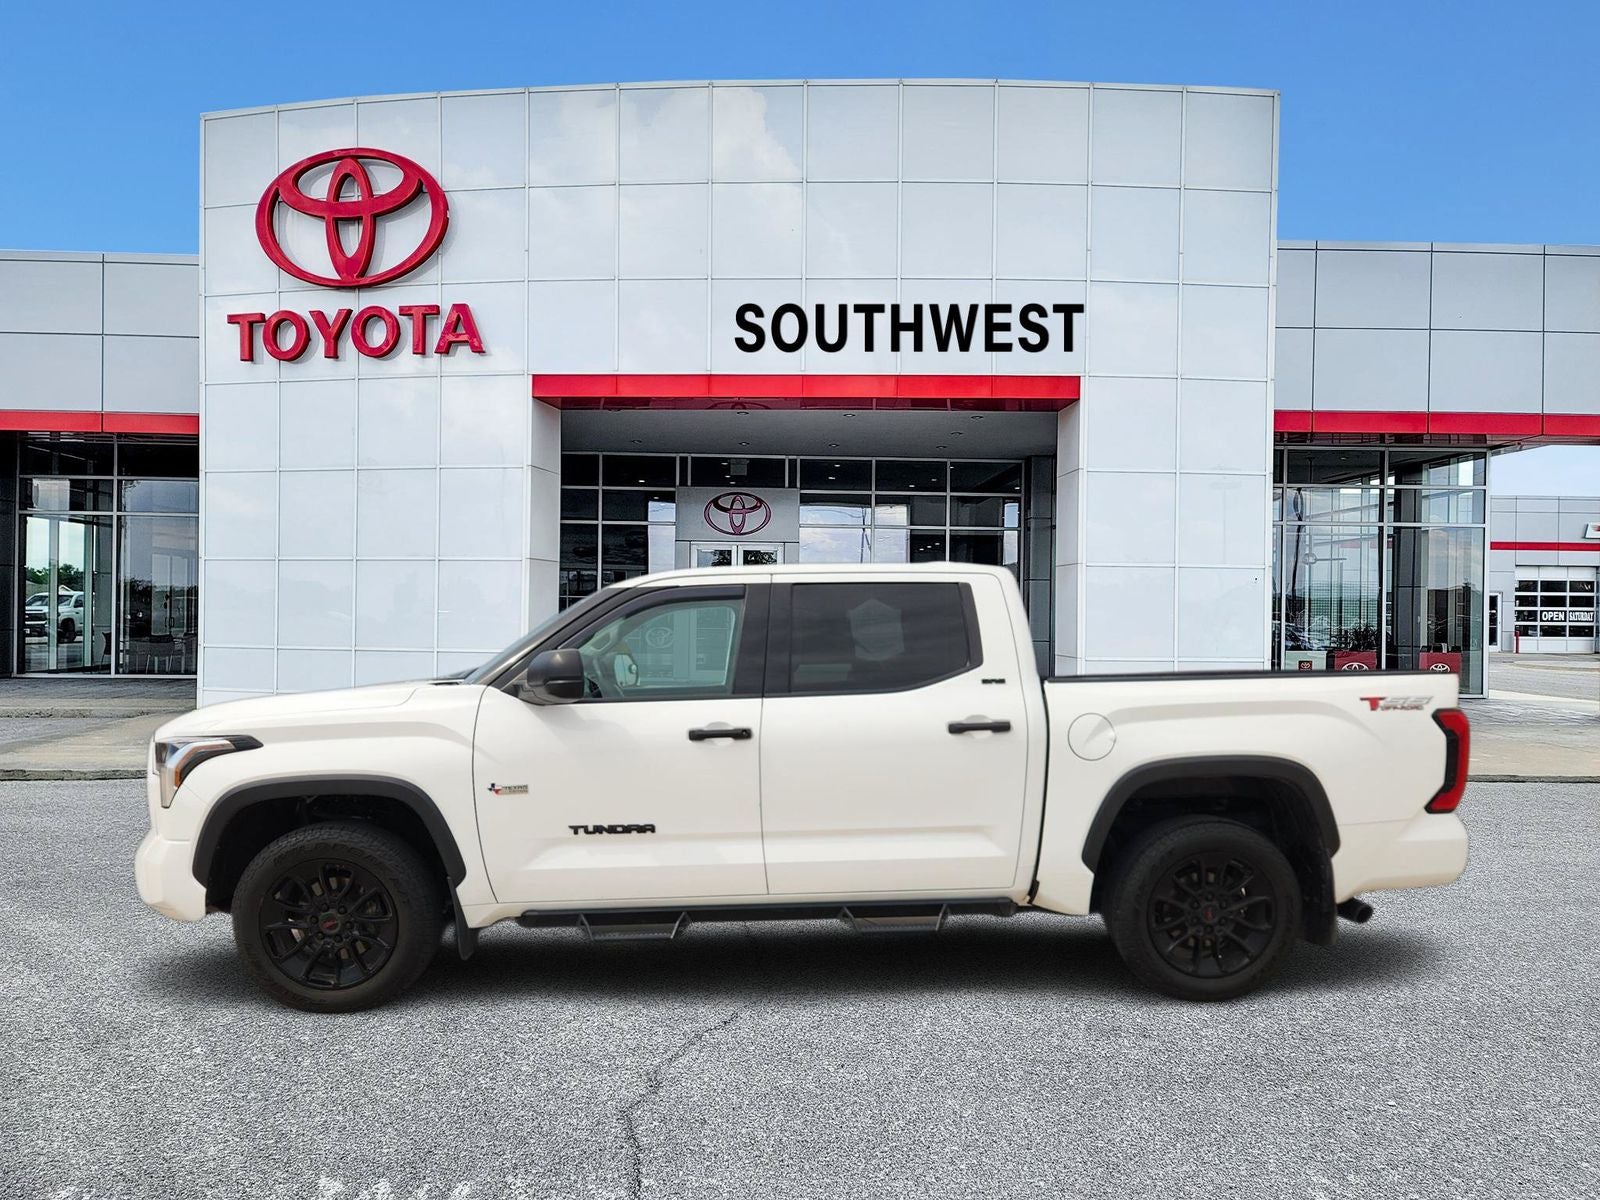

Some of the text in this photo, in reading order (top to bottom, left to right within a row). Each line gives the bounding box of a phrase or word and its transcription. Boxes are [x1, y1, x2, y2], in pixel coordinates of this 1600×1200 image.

[226, 303, 486, 362] TOYOTA
[734, 303, 1085, 353] SOUTHWEST
[1541, 611, 1594, 621] OPEN SATURDAY
[568, 824, 656, 835] TUNDRA
